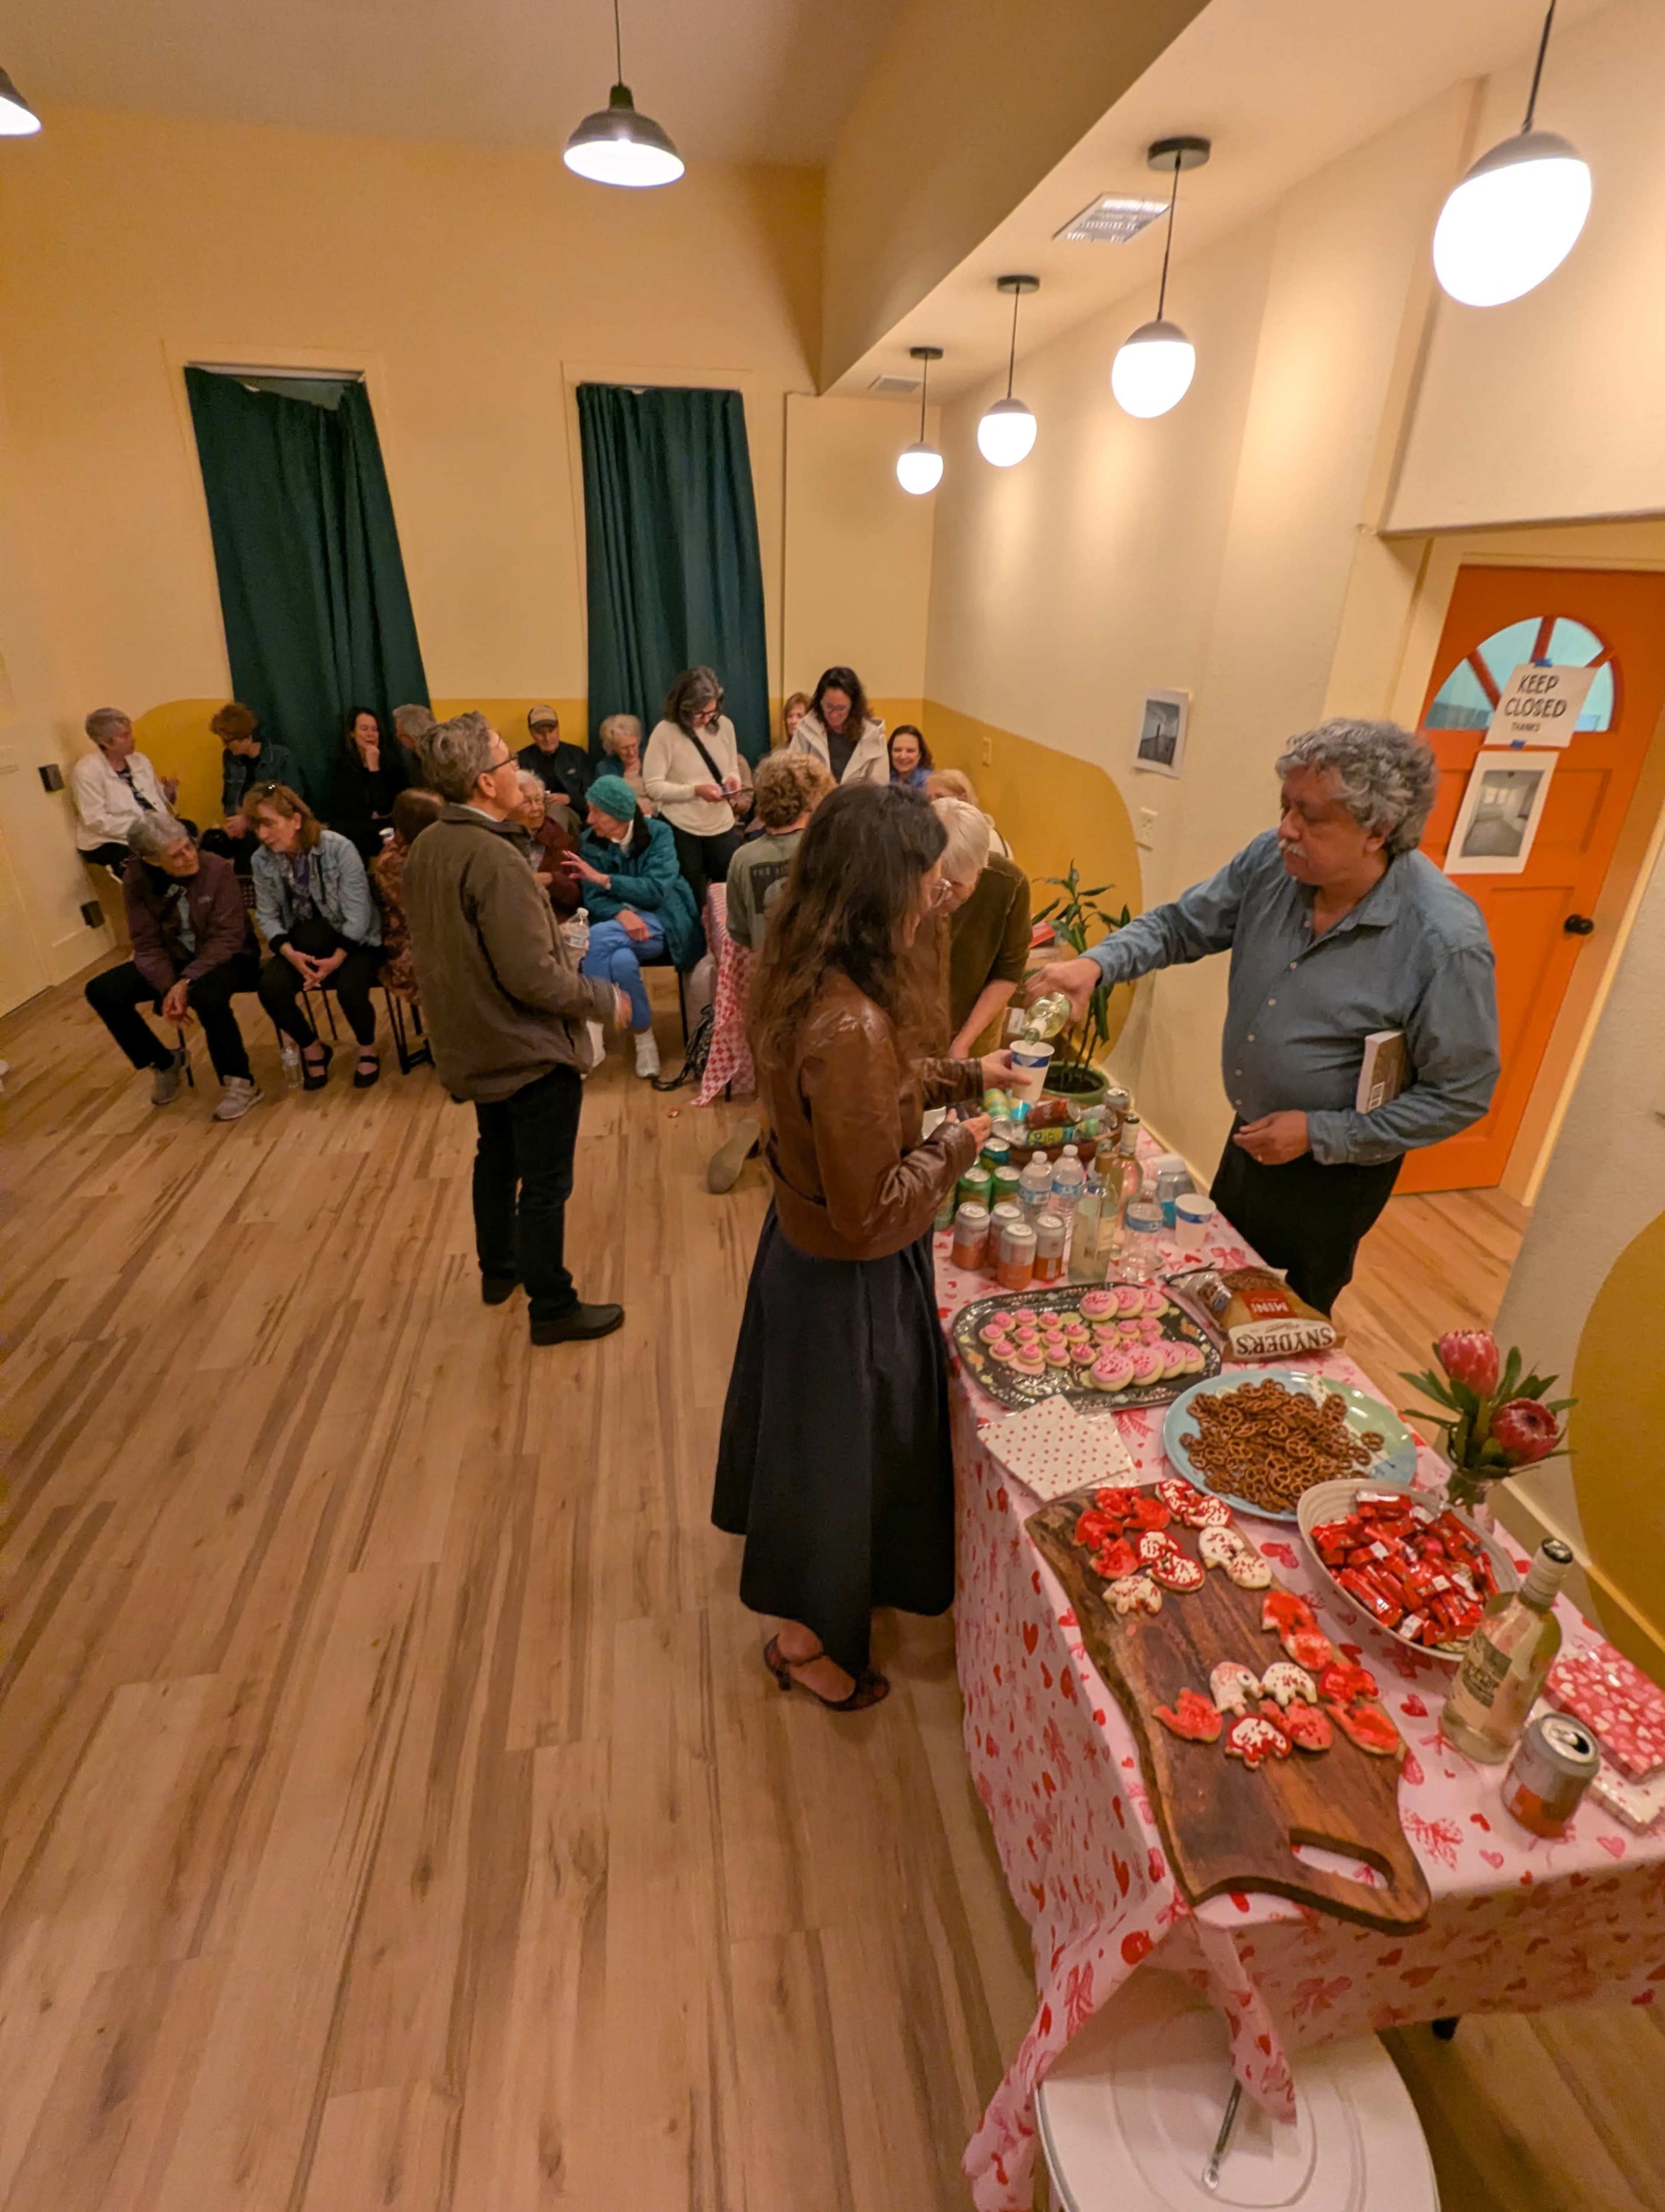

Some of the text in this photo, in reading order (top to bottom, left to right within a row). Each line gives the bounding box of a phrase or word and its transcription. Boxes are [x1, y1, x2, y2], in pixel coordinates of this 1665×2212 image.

[1517, 674, 1560, 694] KEEP
[1505, 697, 1567, 718] CLOSED
[1511, 722, 1541, 732] THANKS
[1250, 1302, 1290, 1313] MINI
[1236, 1327, 1333, 1355] SNYDER'S
